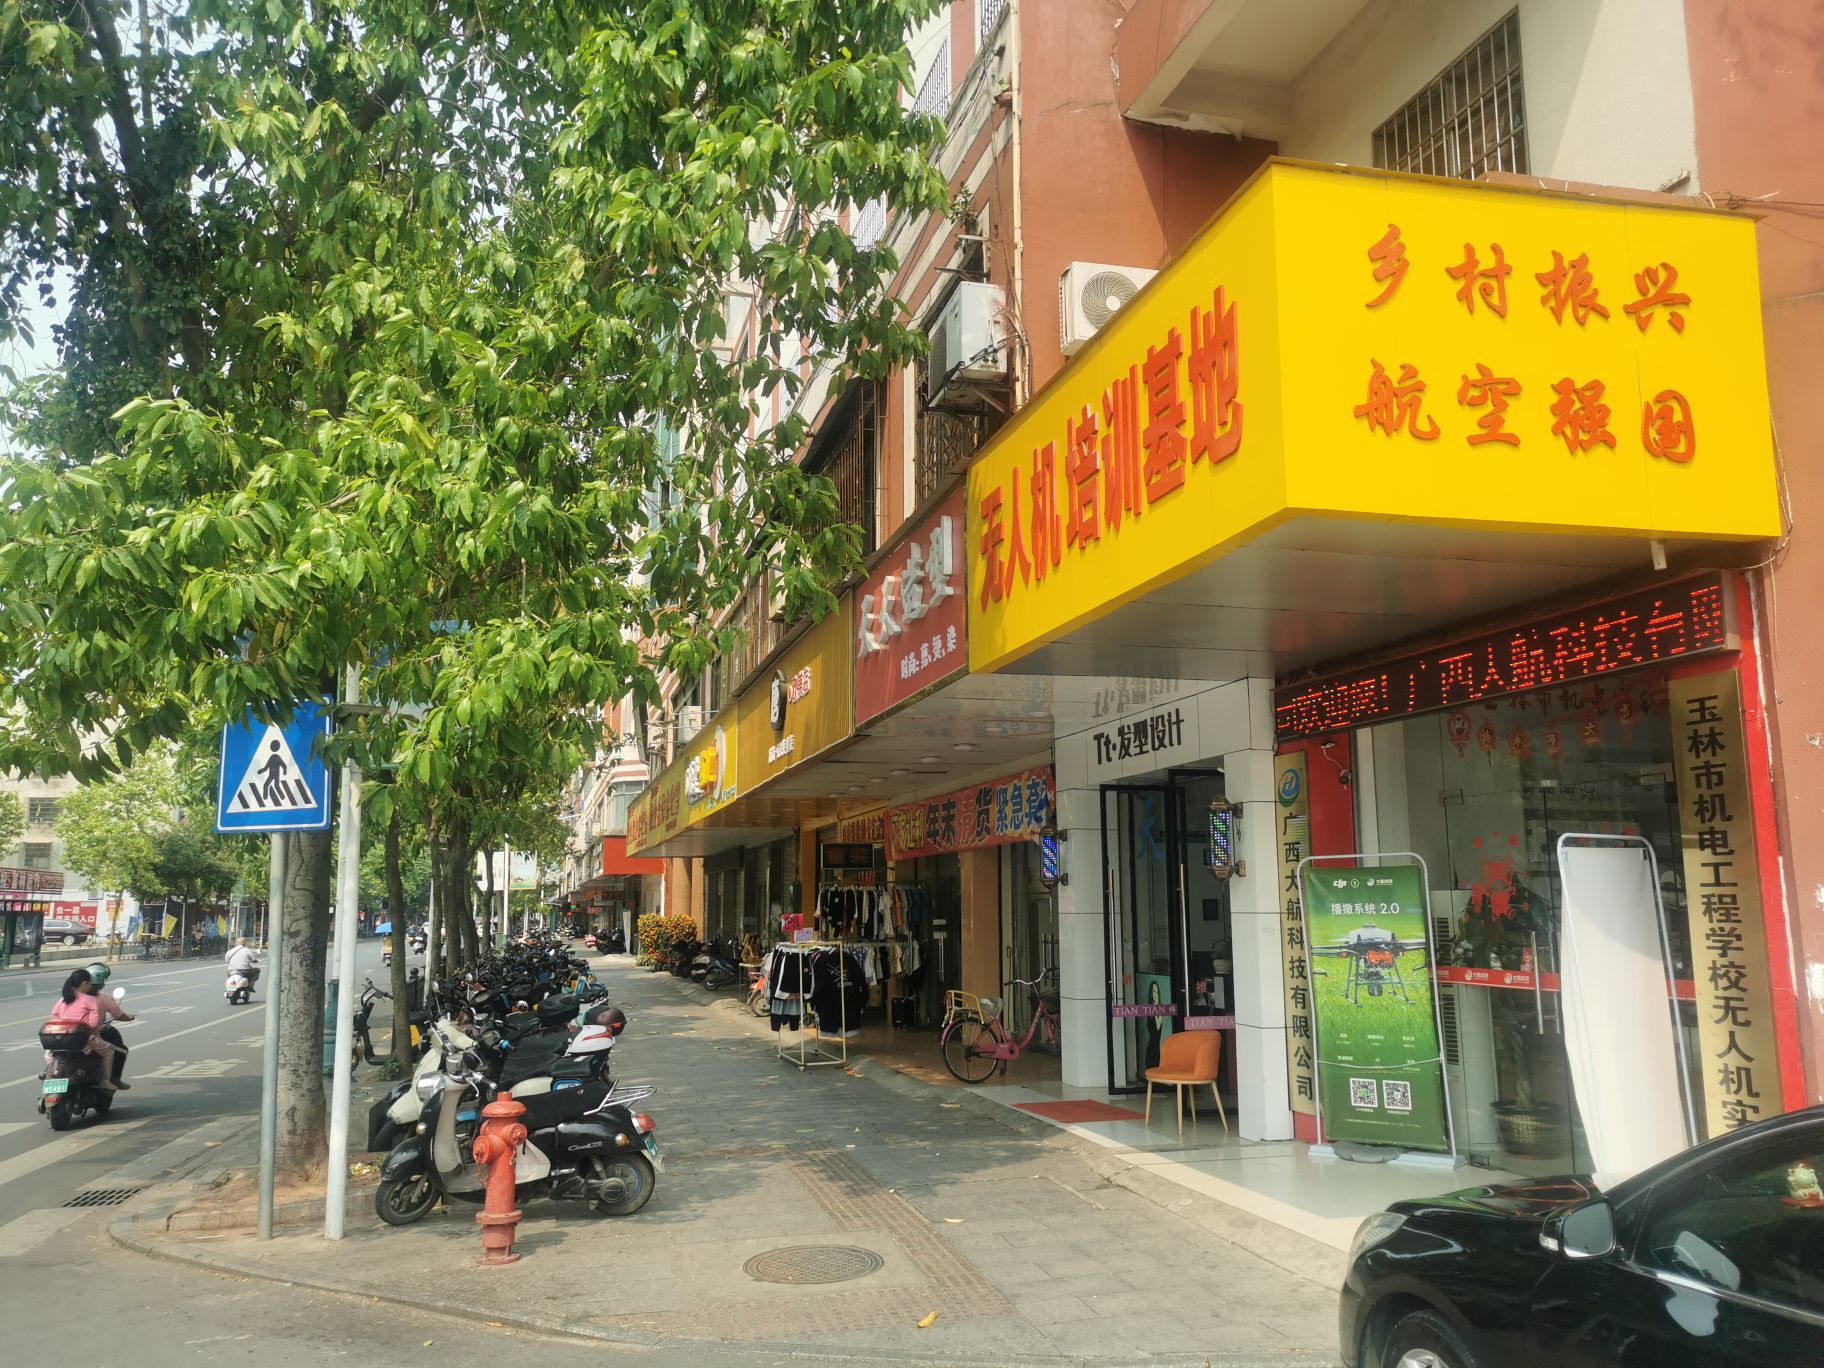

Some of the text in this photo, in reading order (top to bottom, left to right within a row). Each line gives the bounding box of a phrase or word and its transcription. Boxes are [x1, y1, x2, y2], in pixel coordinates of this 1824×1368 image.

[1364, 222, 1692, 334] 乡村振兴
[979, 285, 1242, 614] 无人机培训基地
[1353, 357, 1697, 464] 航空强国
[1282, 811, 1314, 1102] 广西大航科技有限公司
[1330, 902, 1400, 915] 播撒系统 2.0
[1114, 1007, 1138, 1016] TIAN
